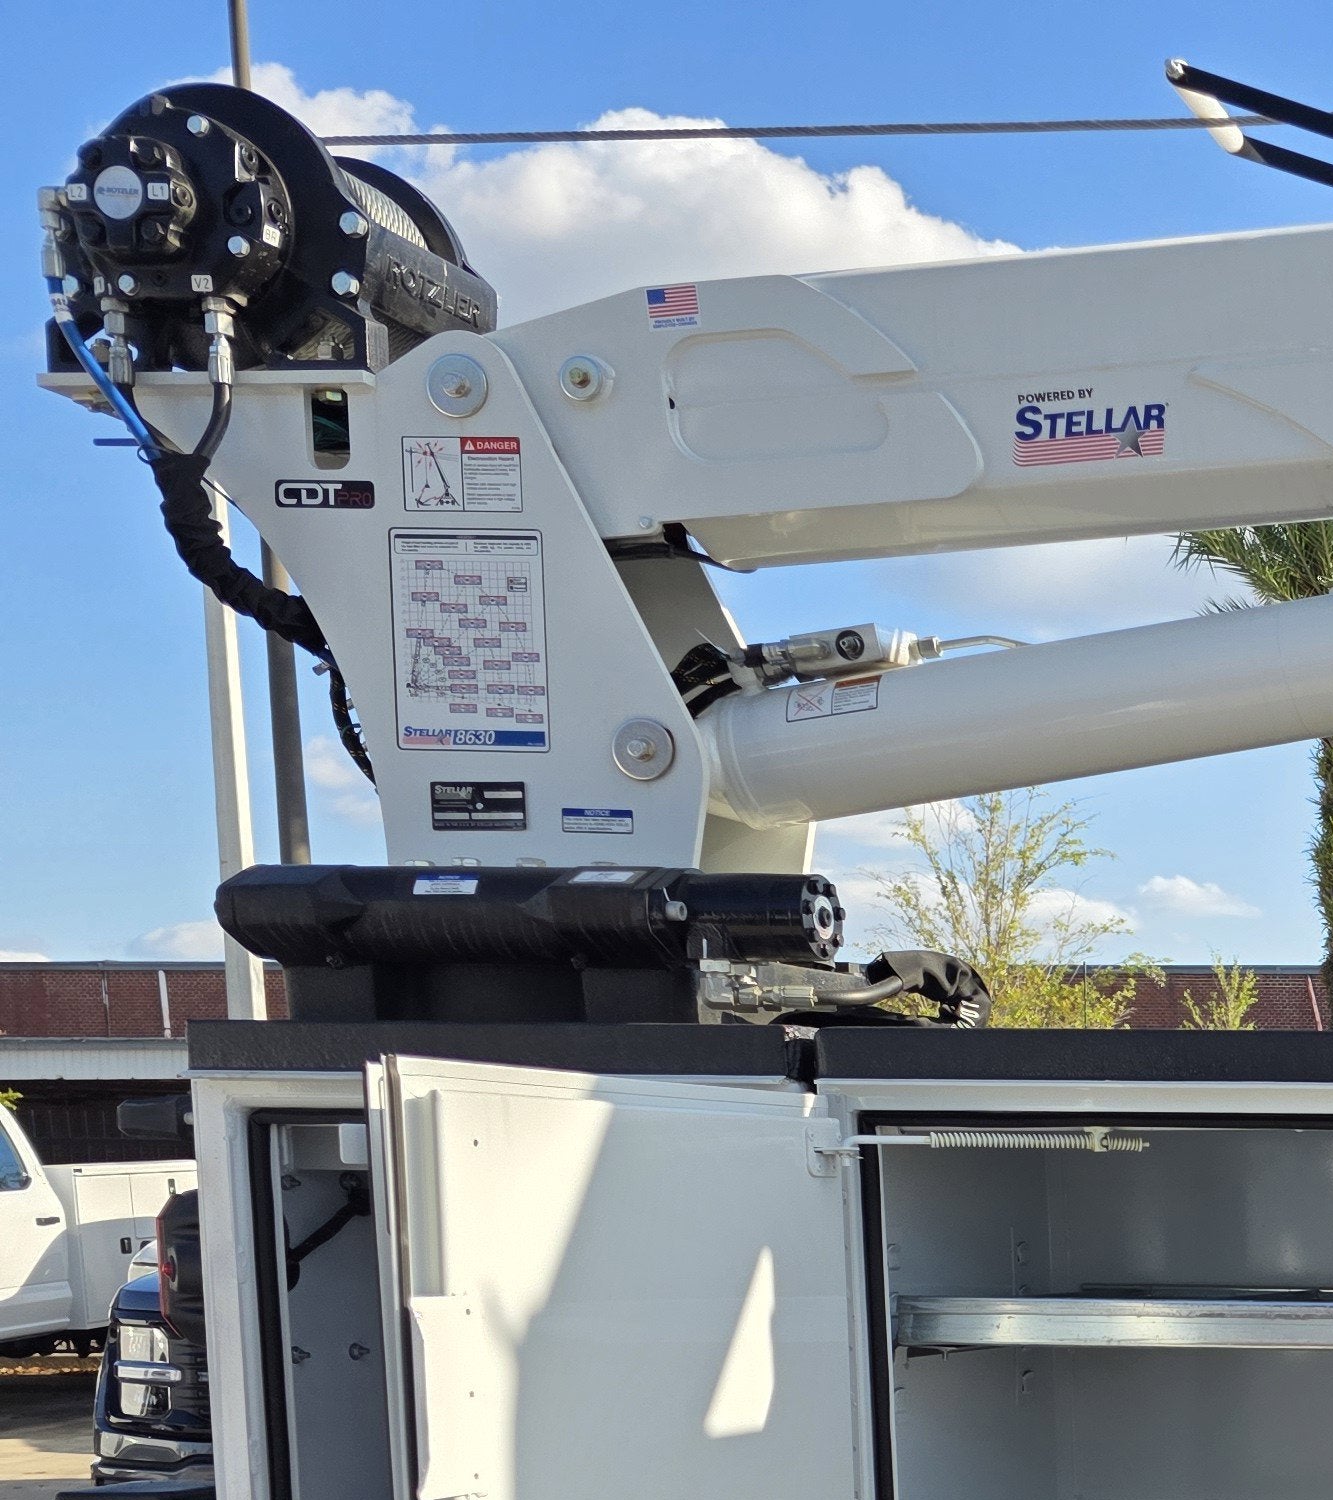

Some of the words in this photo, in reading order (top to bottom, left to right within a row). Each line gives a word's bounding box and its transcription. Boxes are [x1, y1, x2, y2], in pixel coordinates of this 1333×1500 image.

[70, 186, 83, 198] L2
[151, 185, 164, 197] L1
[193, 277, 210, 291] V2
[1017, 390, 1075, 405] POWERED
[1078, 388, 1094, 399] BY
[1014, 403, 1166, 441] STELLAR
[476, 441, 518, 450] DANGER
[278, 482, 343, 506] CDT
[337, 491, 372, 507] PRO
[403, 725, 451, 738] STELLAR
[455, 730, 496, 745] 8630
[434, 784, 473, 794] STELLAR
